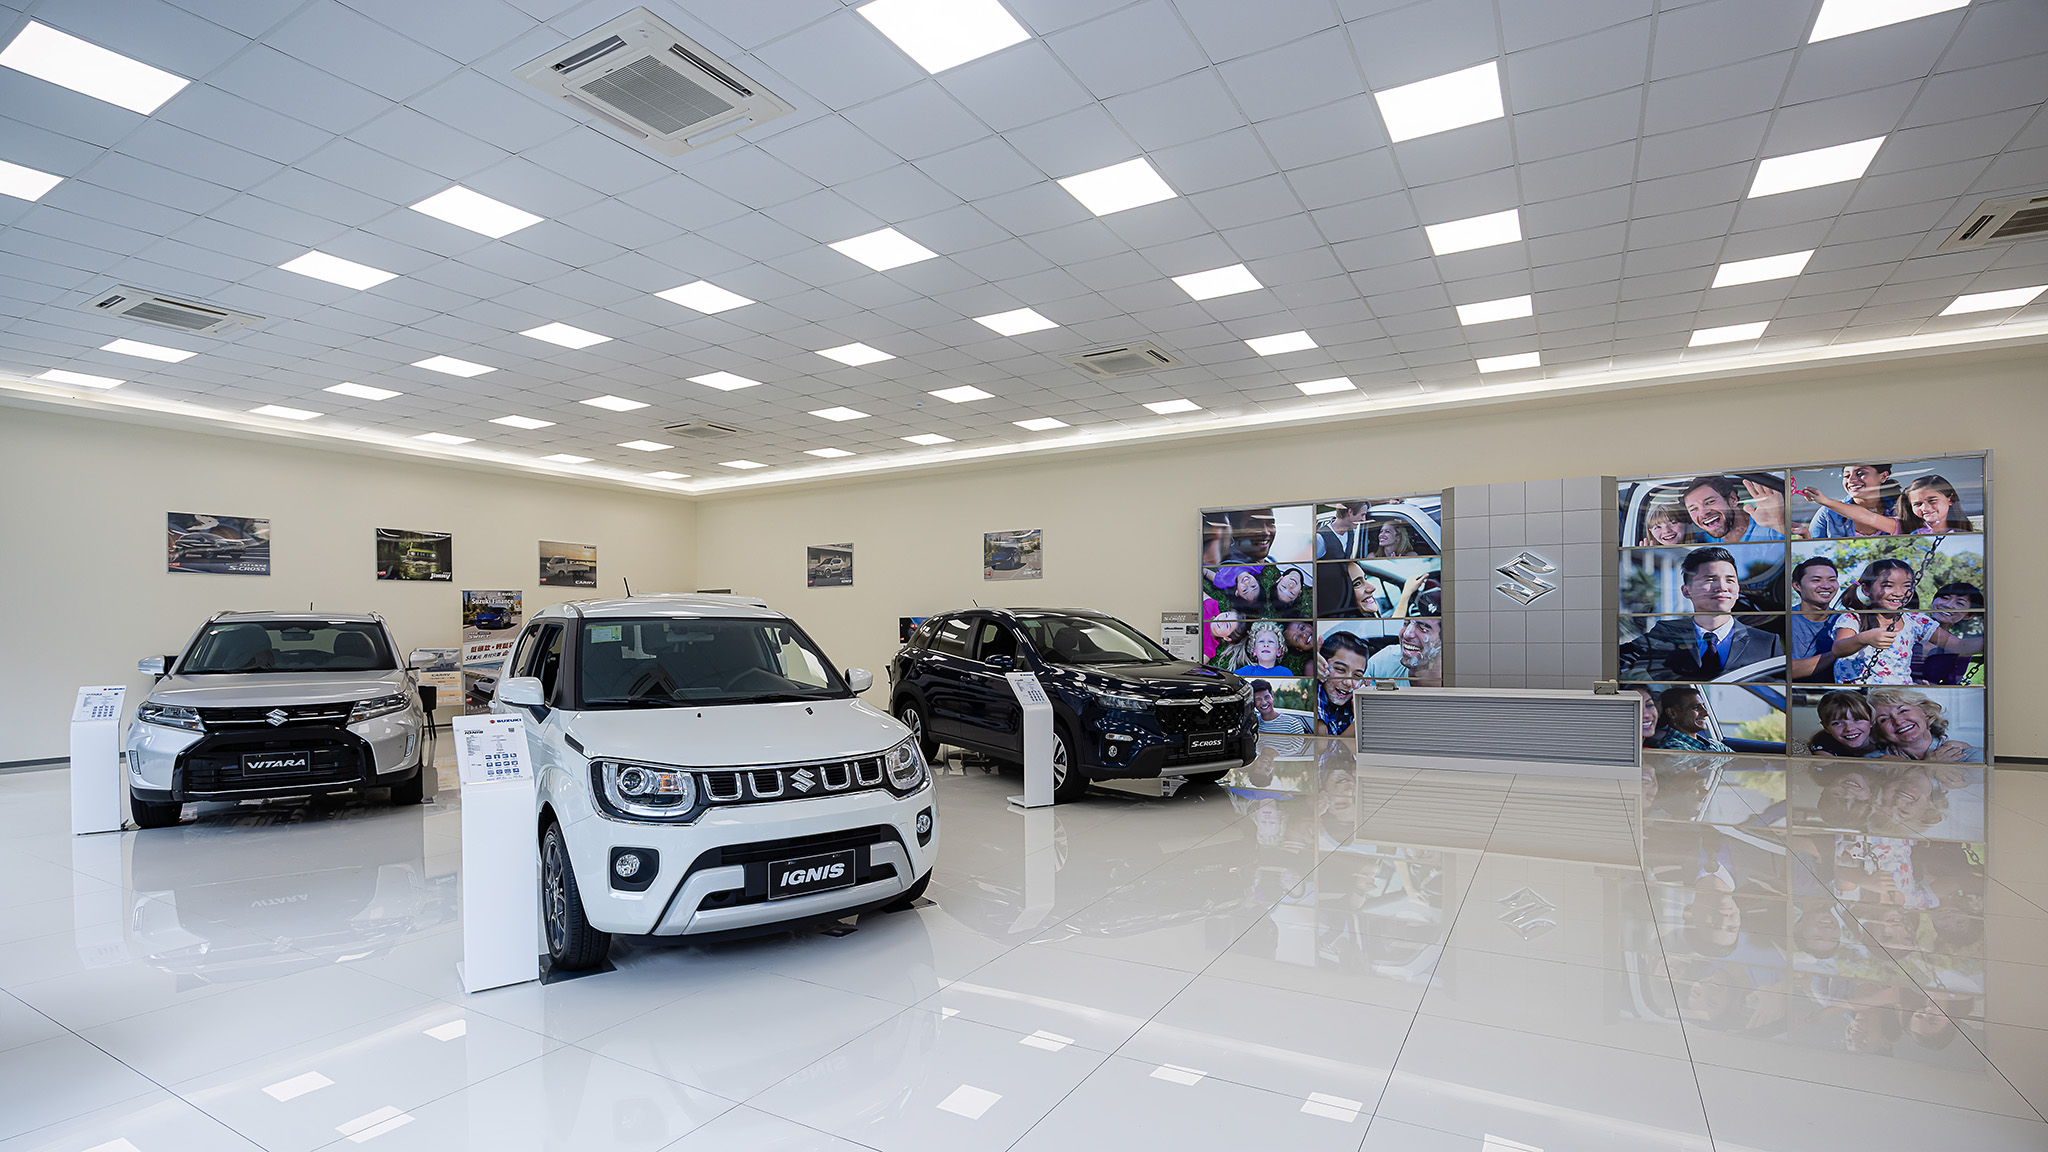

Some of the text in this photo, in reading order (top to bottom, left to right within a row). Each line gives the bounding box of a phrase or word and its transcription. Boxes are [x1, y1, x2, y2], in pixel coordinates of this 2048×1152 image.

[1191, 739, 1222, 748] S-CROSS
[247, 759, 306, 769] VITARA
[780, 862, 845, 887] IGNIS
